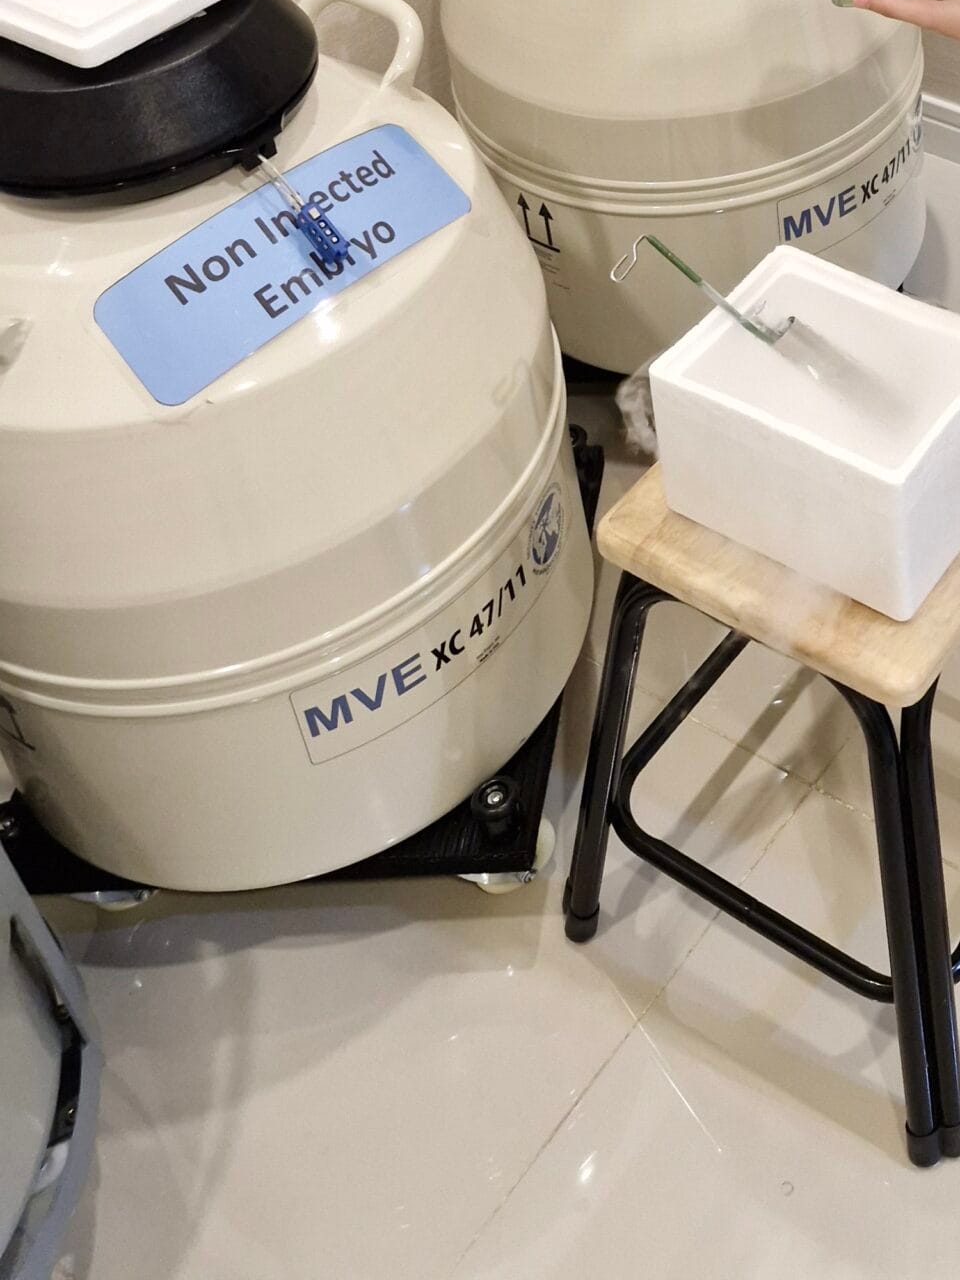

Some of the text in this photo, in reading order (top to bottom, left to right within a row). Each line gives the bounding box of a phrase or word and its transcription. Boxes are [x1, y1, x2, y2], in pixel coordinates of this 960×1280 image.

[164, 149, 396, 306] Non Inected
[783, 138, 911, 242] MVE XC 47/11
[304, 564, 527, 738] MVE XC 47/11
